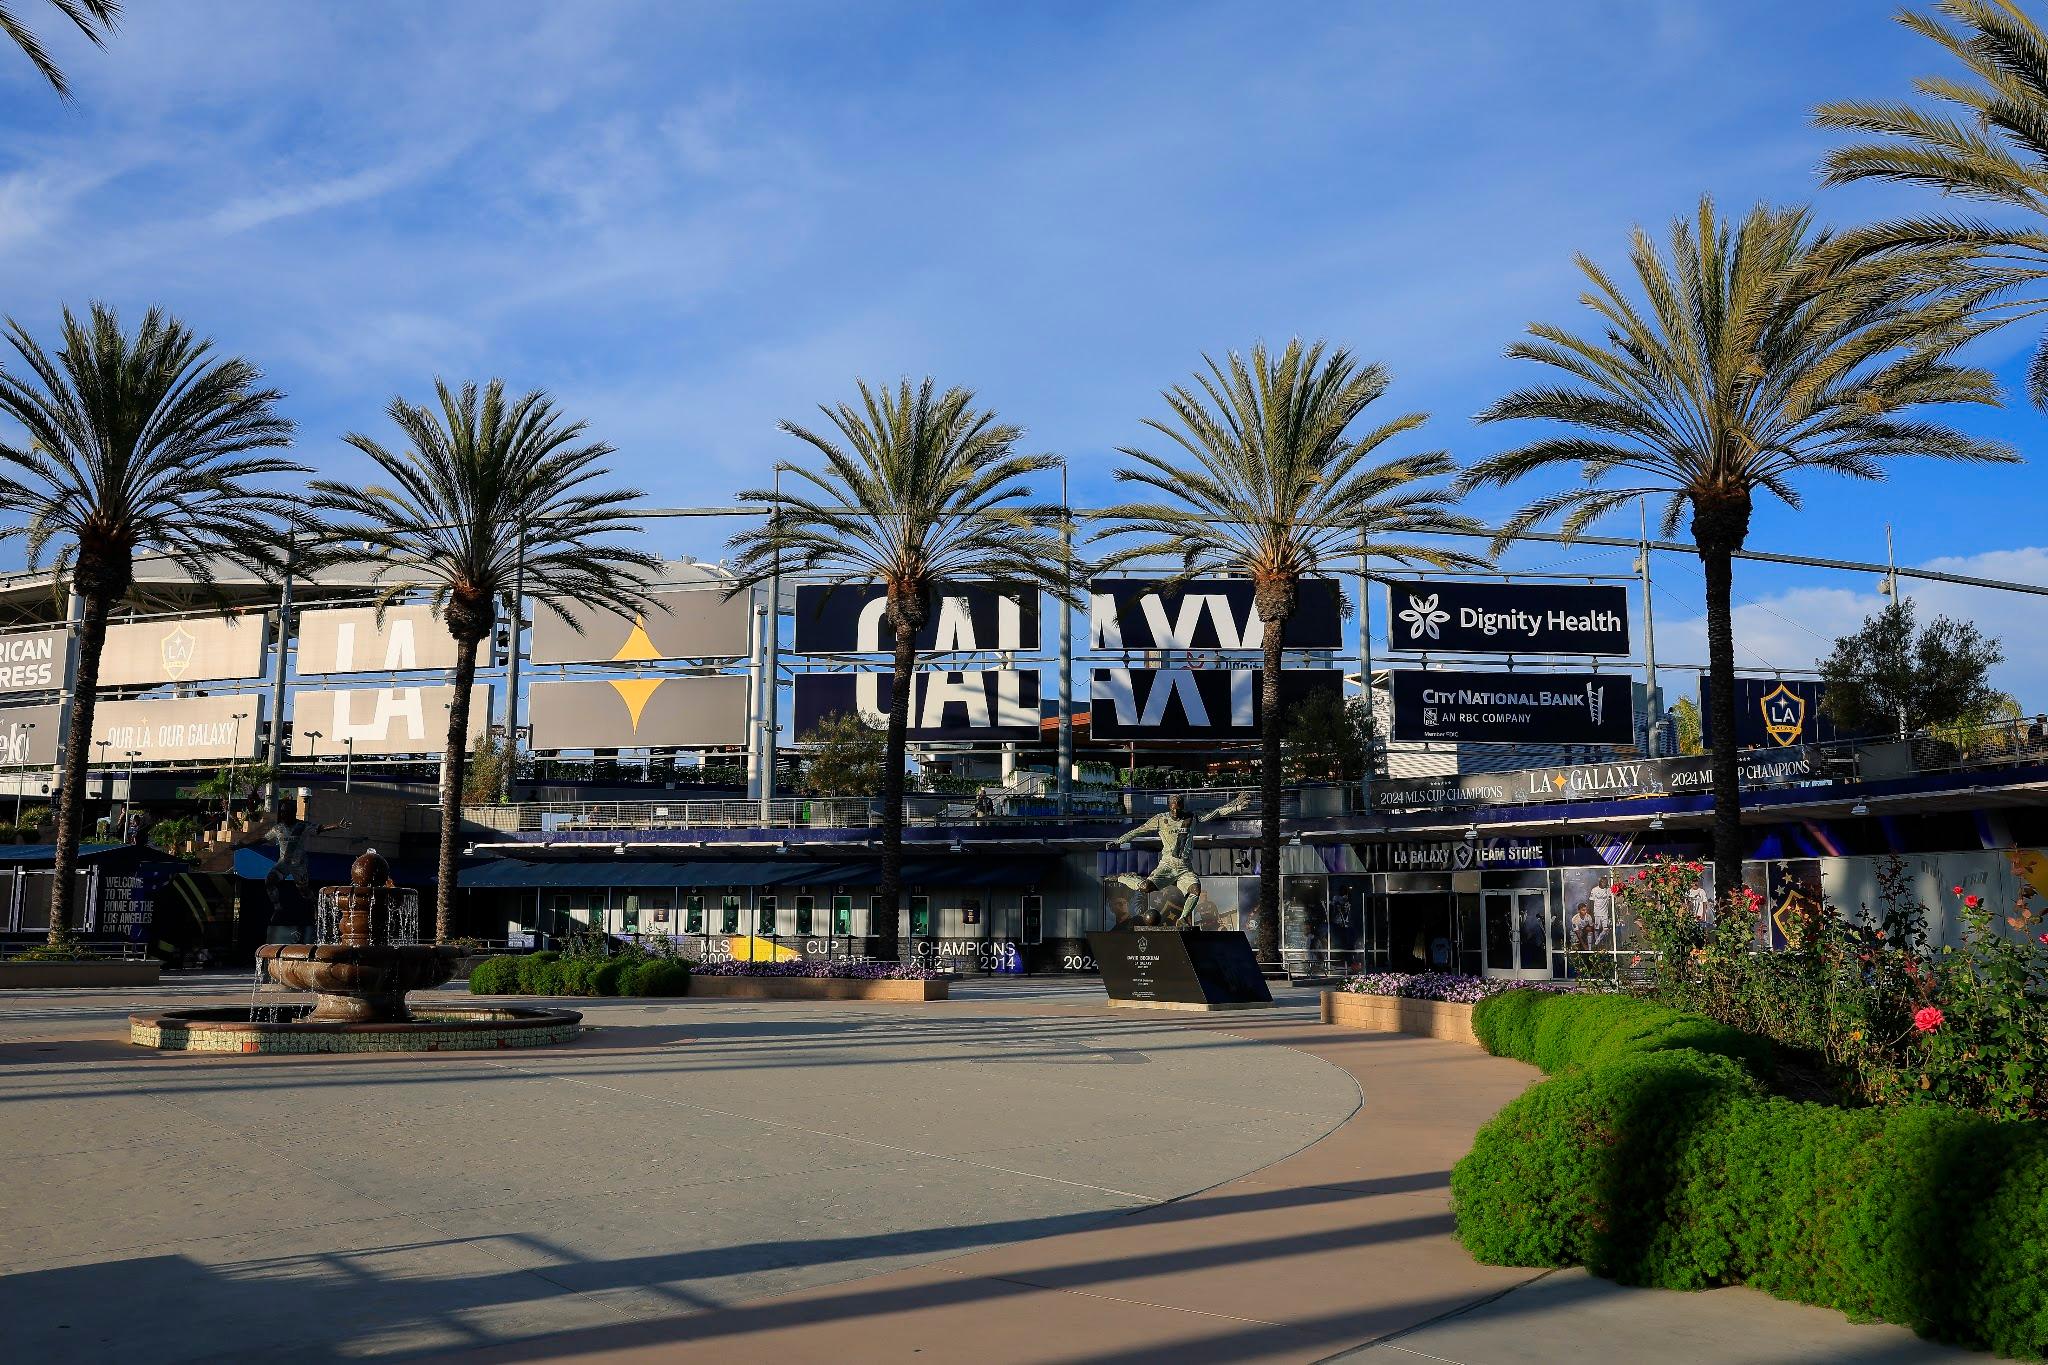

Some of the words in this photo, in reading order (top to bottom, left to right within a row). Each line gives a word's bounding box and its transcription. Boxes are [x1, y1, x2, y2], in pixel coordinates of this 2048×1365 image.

[1460, 608, 1542, 636] Dignity
[1548, 609, 1621, 632] Health
[332, 620, 425, 741] LA
[1422, 689, 1457, 704] CITY
[1458, 690, 1538, 706] NATIONAL
[1540, 692, 1585, 706] BANK
[1442, 712, 1456, 722] AN
[1459, 713, 1479, 723] RBC
[1482, 713, 1531, 723] COMPANY
[1771, 707, 1796, 723] LA
[108, 726, 133, 749] OUR
[159, 724, 185, 748] OUR
[1746, 759, 1810, 779] CHAMPIONS
[1530, 772, 1552, 794] LA
[1570, 764, 1642, 791] GALAXY
[1671, 771, 1698, 786] 2024
[1380, 791, 1404, 805] 2024
[1405, 790, 1425, 804] MLS
[1427, 789, 1446, 802] CUP
[1447, 785, 1503, 801] CHAMPIONS
[1394, 850, 1407, 864] LA
[1410, 849, 1450, 864] GALAXY
[1475, 848, 1505, 862] TEAM
[1508, 845, 1543, 860] STORE
[105, 876, 144, 889] WELCOME
[105, 888, 115, 900] TO
[117, 888, 132, 900] THE
[104, 900, 127, 912] HOME
[129, 900, 139, 912] OF
[140, 900, 154, 912] THE
[103, 912, 118, 924] LOS
[119, 912, 153, 924] ANGELES
[700, 939, 731, 953] MLS
[806, 940, 839, 954] CUP
[917, 941, 1016, 956] CHAMPIONS
[700, 953, 733, 964] 2002
[980, 956, 1016, 970] 2014
